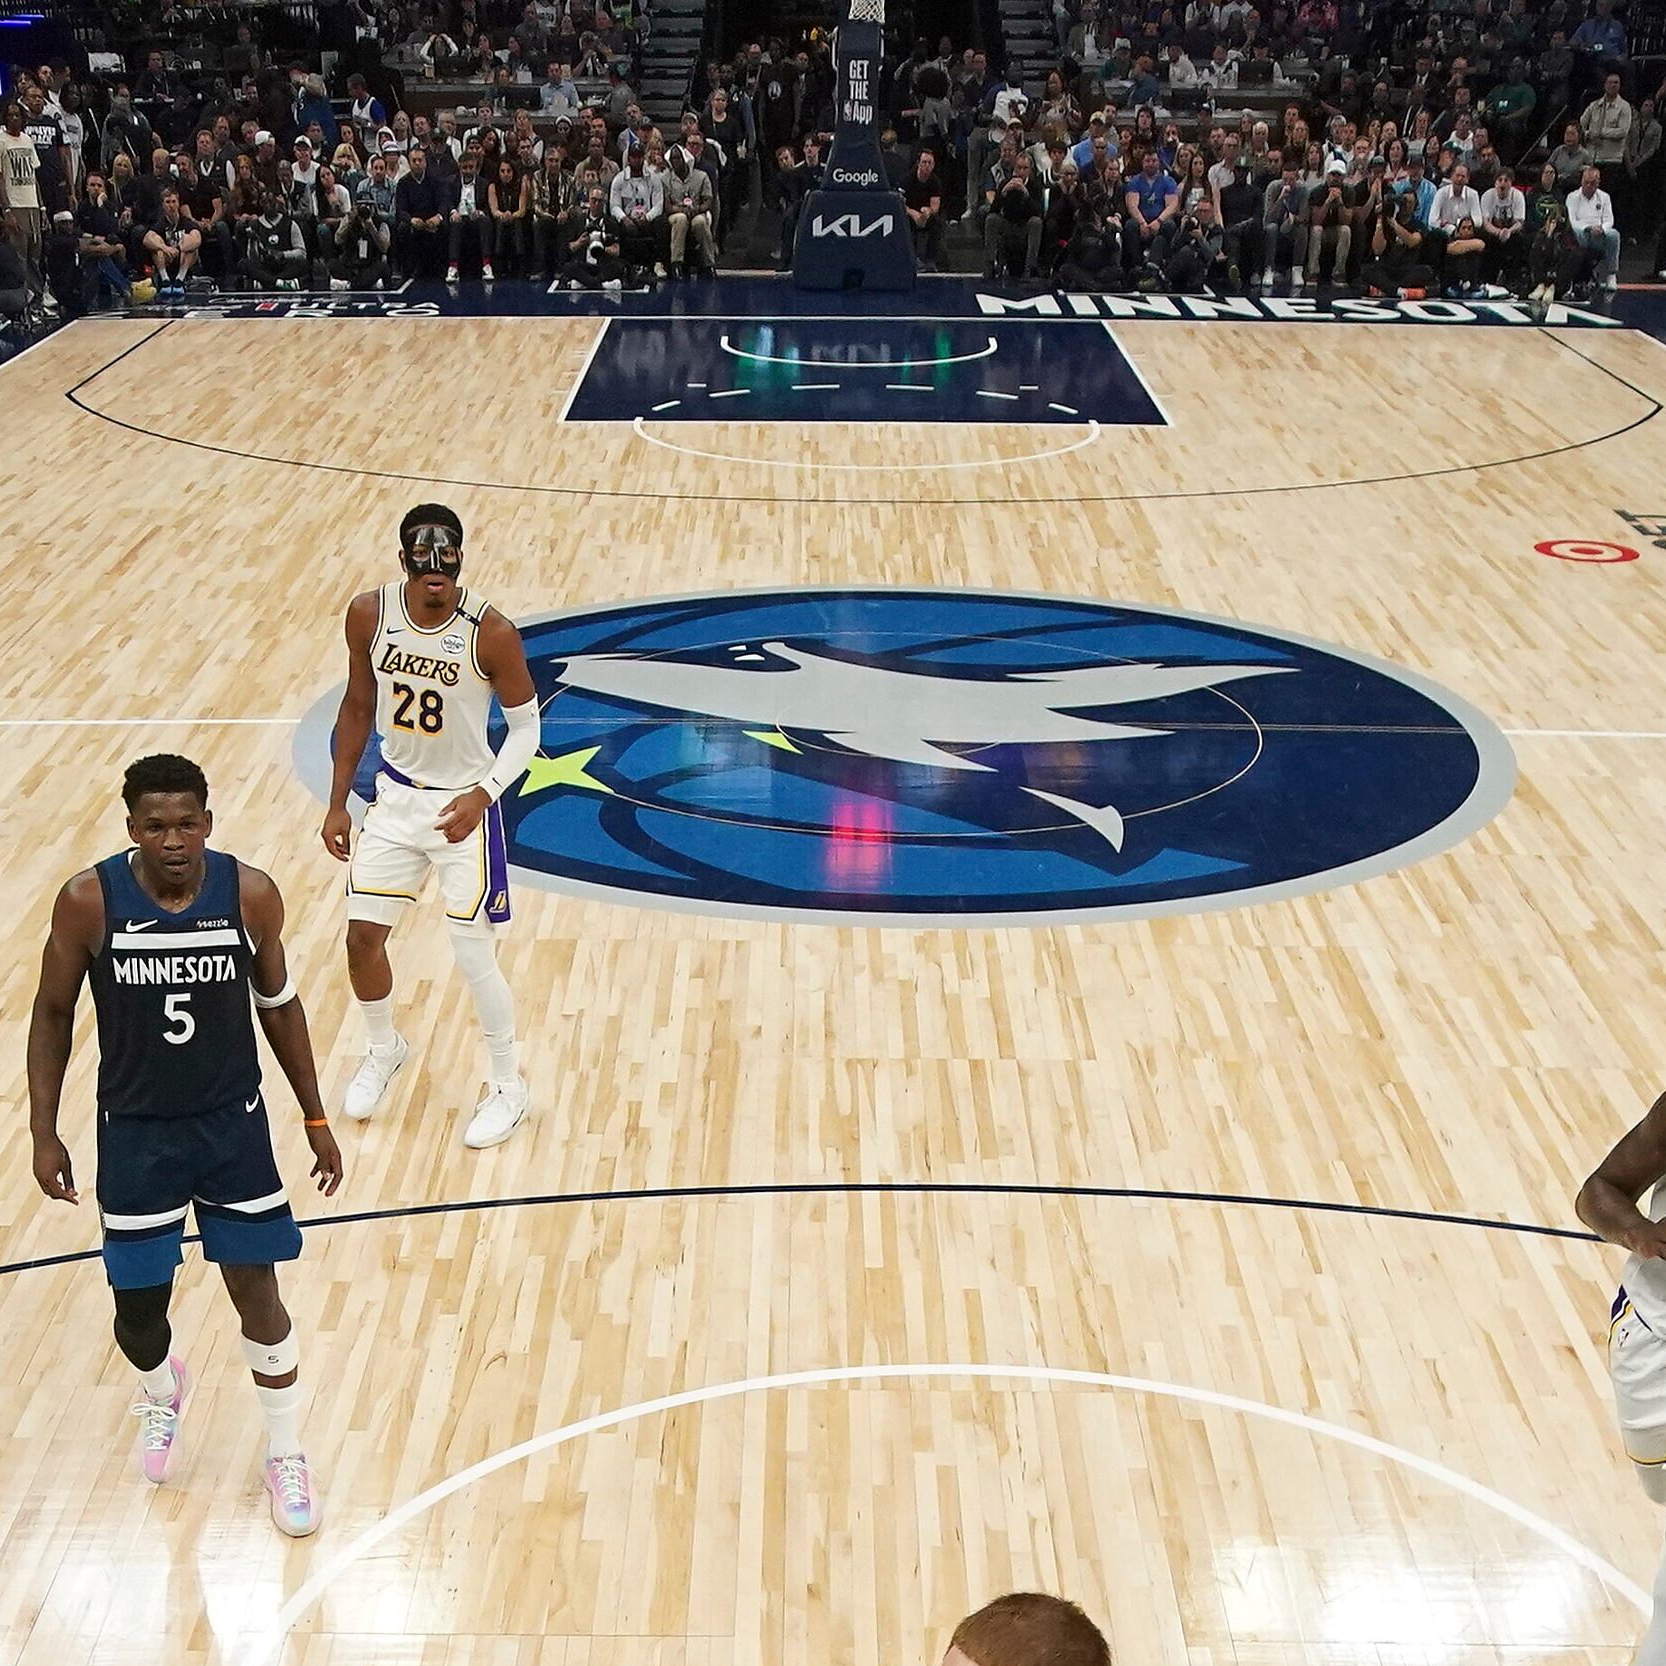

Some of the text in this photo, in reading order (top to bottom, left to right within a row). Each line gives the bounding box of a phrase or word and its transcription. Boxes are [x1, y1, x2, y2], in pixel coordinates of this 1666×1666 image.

[849, 60, 869, 79] GET
[849, 81, 869, 100] THE
[852, 102, 873, 124] App
[832, 167, 879, 187] Google
[974, 293, 1624, 325] MINNESOTA
[376, 642, 461, 687] LAKERS
[391, 681, 445, 737] 28
[111, 954, 237, 985] MINNESOTA
[162, 992, 197, 1045] 5
